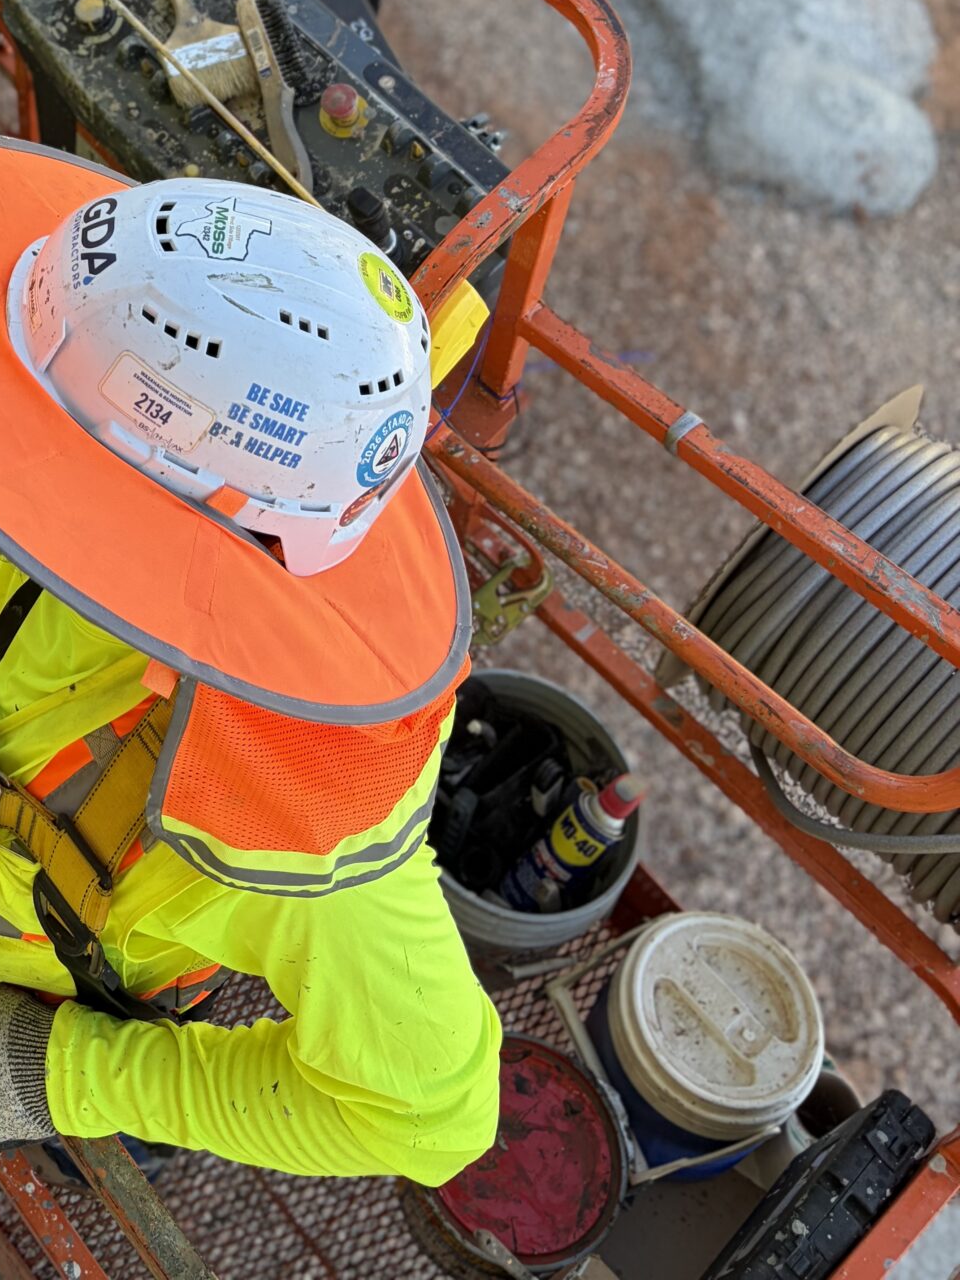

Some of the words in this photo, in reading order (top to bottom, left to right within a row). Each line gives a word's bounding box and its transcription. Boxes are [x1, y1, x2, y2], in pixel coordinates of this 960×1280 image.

[71, 209, 84, 290] CONTRACTORS
[83, 197, 118, 276] GDA
[212, 206, 229, 254] MOSS
[134, 392, 173, 426] 2134
[227, 402, 251, 425] BE
[249, 413, 308, 446] SMART
[246, 383, 271, 407] BE
[269, 392, 310, 422] SAFE
[243, 436, 302, 469] HELPER
[560, 815, 599, 858] WD-40
